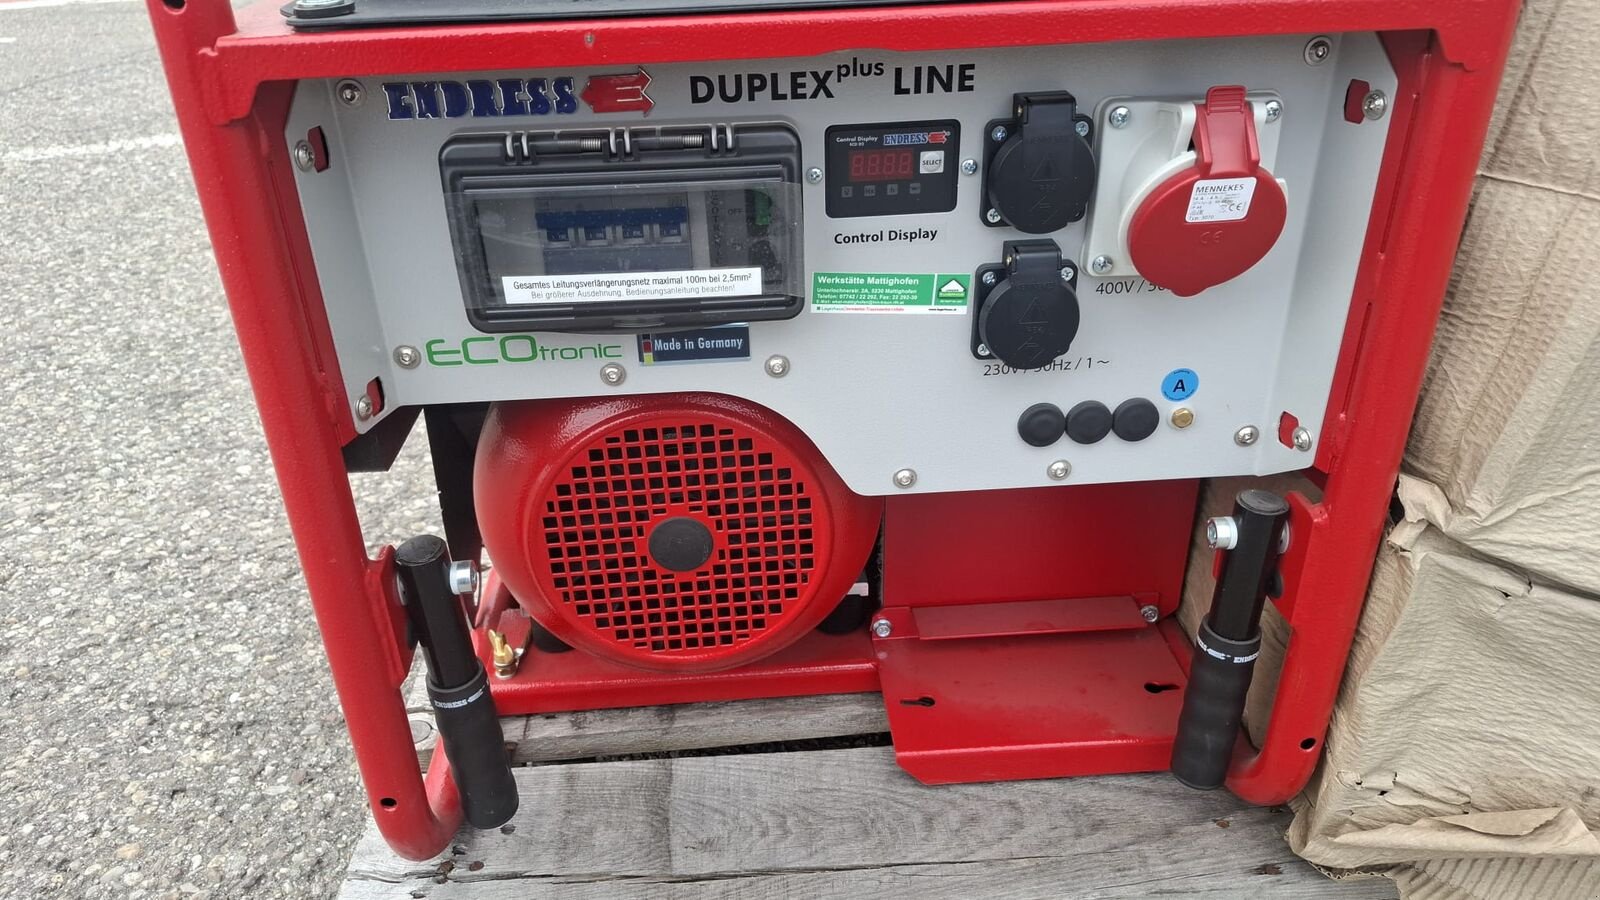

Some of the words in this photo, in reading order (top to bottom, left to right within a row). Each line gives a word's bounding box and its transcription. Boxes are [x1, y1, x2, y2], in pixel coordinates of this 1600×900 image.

[894, 63, 976, 96] LINE
[382, 77, 579, 121] ENDRESS
[858, 135, 878, 143] Display
[883, 132, 929, 146] ENDRESS
[1195, 183, 1245, 193] MENNEKES
[834, 230, 884, 245] Control
[888, 228, 938, 243] Display
[513, 280, 551, 290] Gesamtes
[552, 277, 650, 289] Leitungsverlängerungsnetz
[652, 275, 683, 286] maximal
[685, 275, 707, 284] 100m
[708, 274, 720, 283] bei
[722, 272, 752, 283] 2,5mm²
[817, 275, 865, 284] Werkstätte
[867, 276, 919, 286] Mattighofen
[1095, 279, 1135, 295] 400V
[1136, 279, 1145, 294] /
[531, 291, 543, 299] Bei
[545, 291, 575, 300] größerer
[625, 286, 700, 297] Bedienungsanleitung
[701, 284, 735, 294] beachten!
[425, 335, 623, 366] ECOtronic
[654, 339, 682, 351] Made
[683, 338, 695, 350] in
[697, 336, 744, 350] Germany
[1074, 357, 1082, 370] /
[1172, 379, 1186, 392] A
[434, 698, 468, 709] ENDRESS
